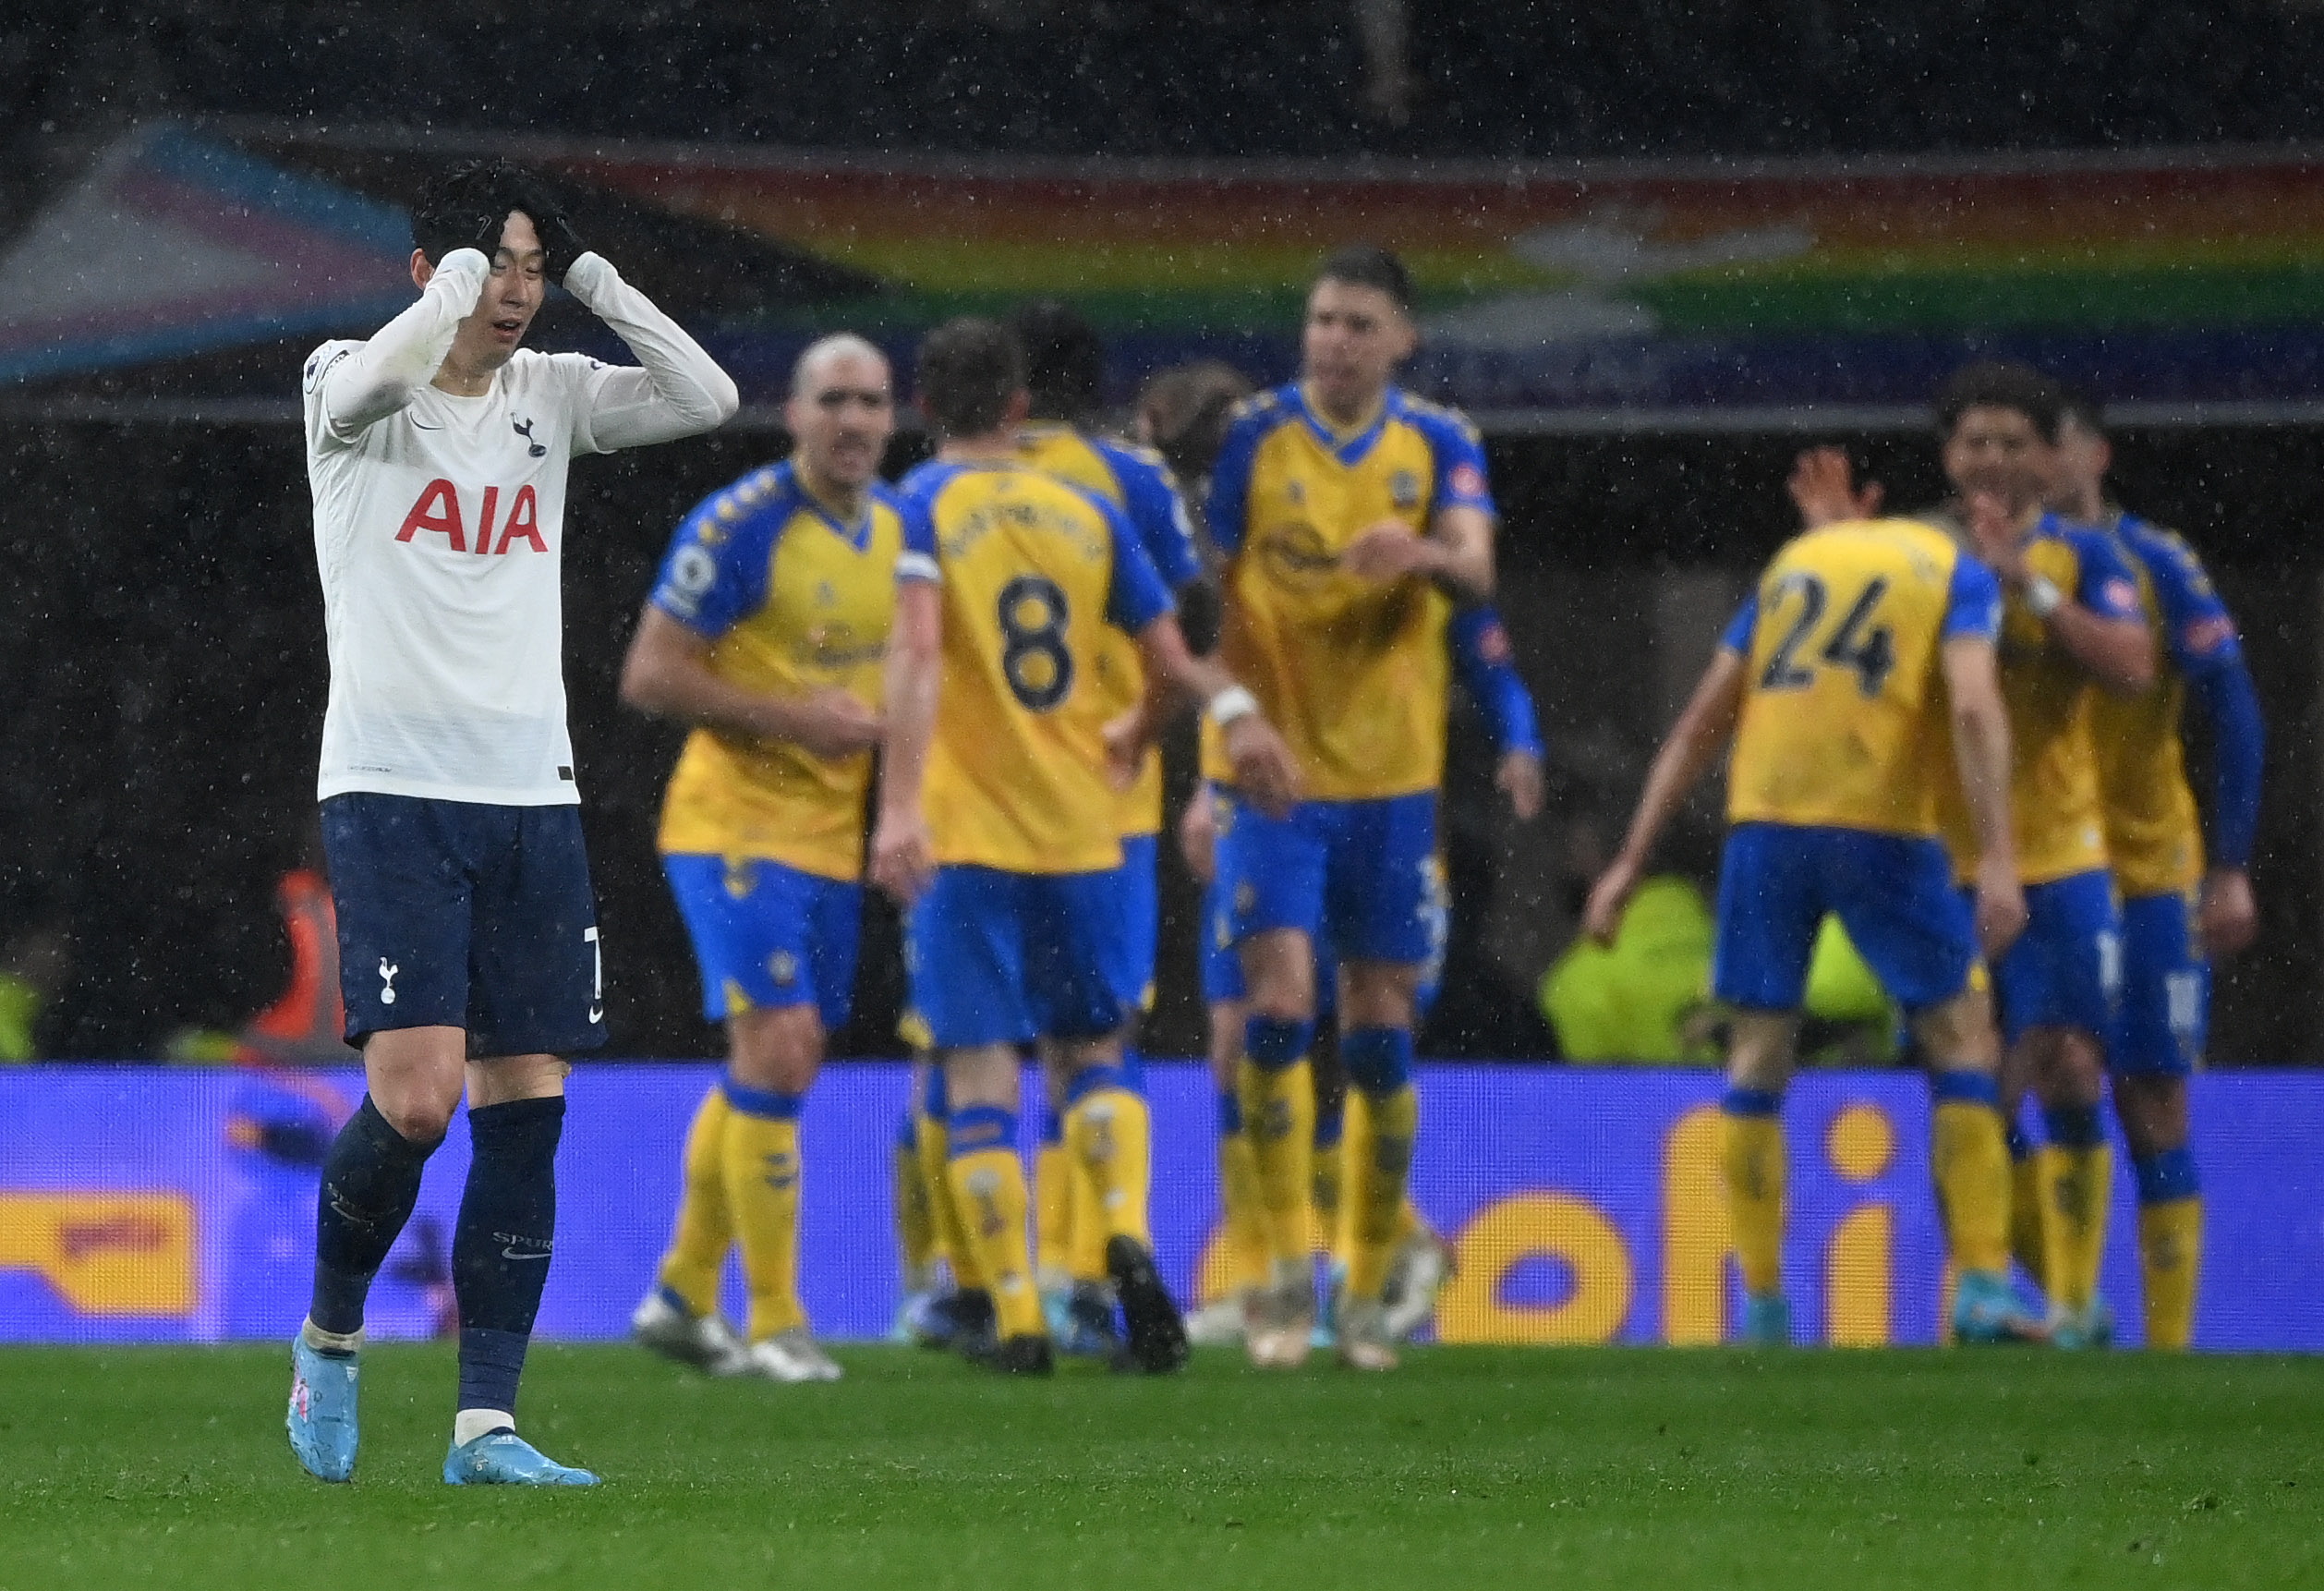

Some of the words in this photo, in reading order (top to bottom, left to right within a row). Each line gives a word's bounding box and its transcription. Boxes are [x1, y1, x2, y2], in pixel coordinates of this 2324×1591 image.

[394, 478, 549, 554] AIA
[998, 575, 1073, 713] 8
[1758, 570, 1895, 698] 24
